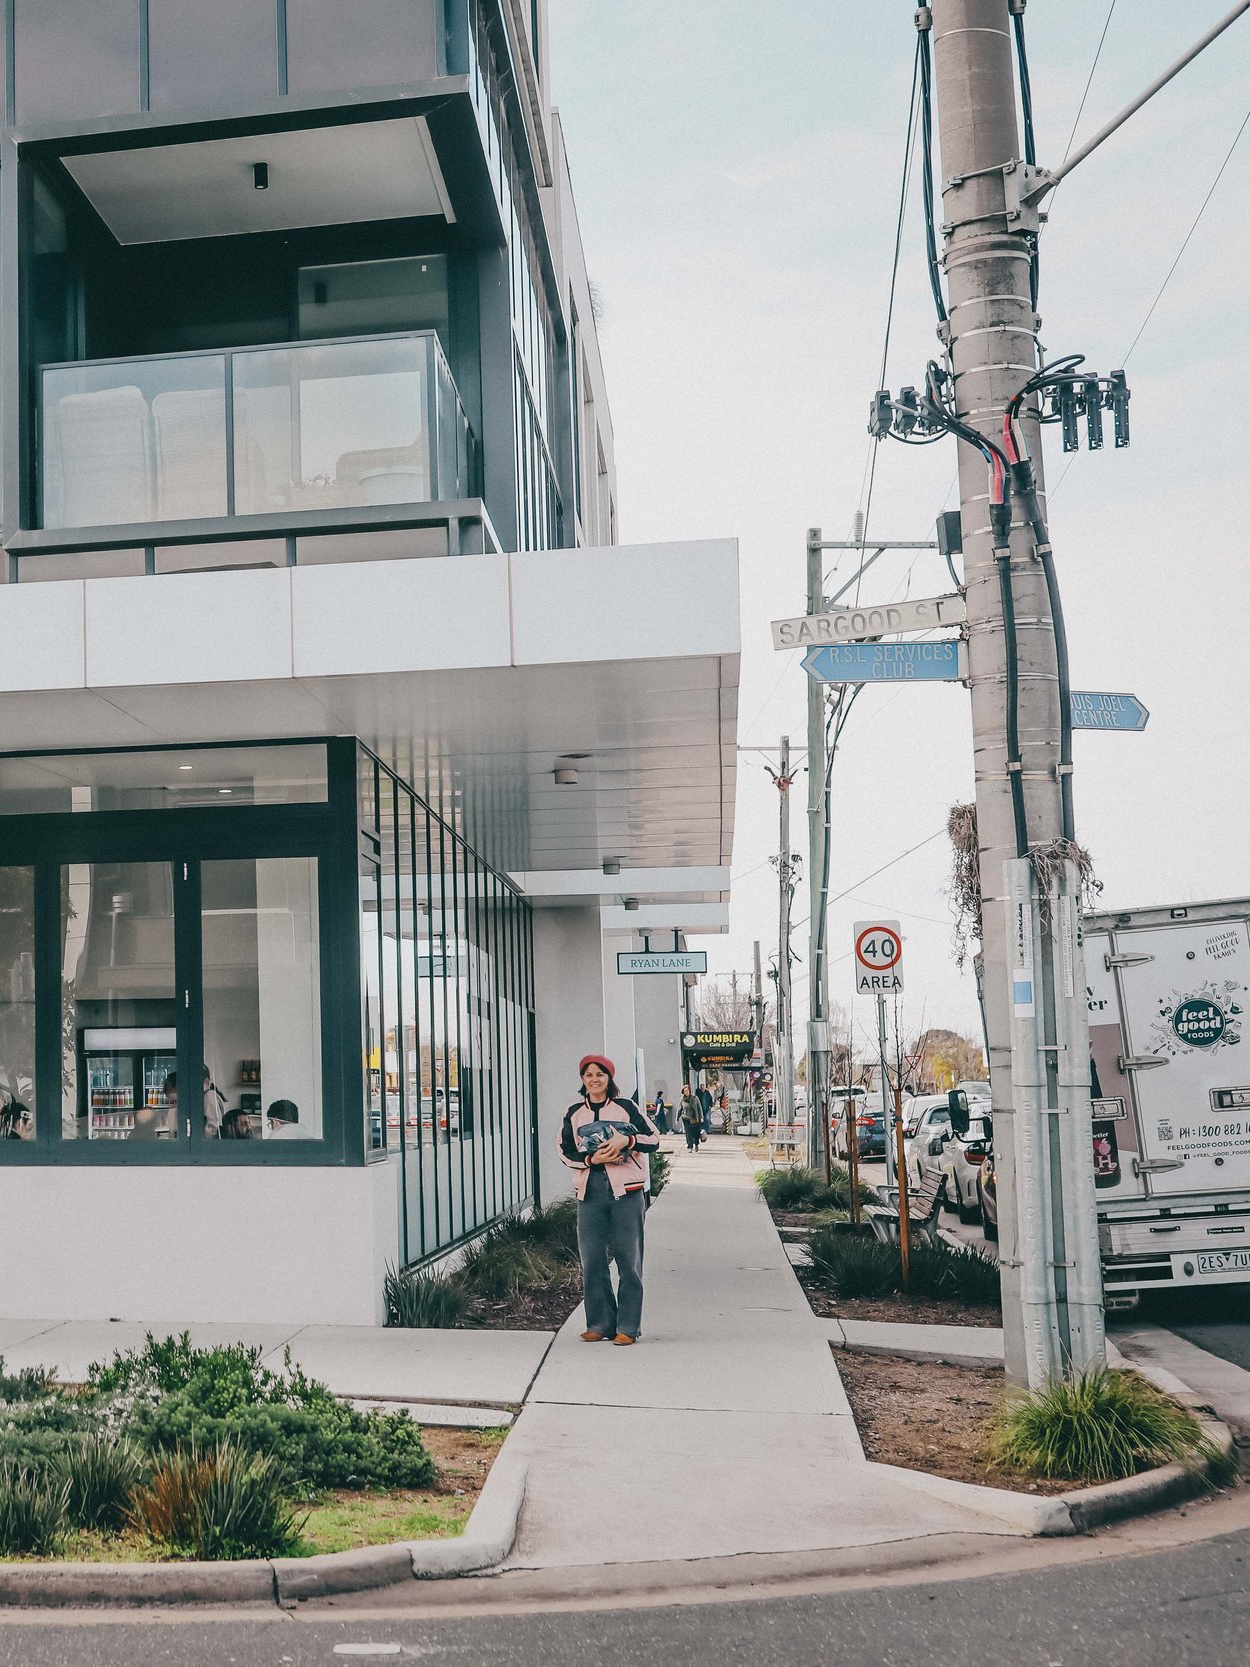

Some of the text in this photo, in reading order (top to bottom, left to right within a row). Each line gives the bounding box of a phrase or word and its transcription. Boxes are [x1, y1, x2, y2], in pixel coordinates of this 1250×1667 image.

[780, 601, 944, 645] SARGOOD ST
[873, 644, 954, 662] SERVICES
[872, 663, 915, 679] CLUB
[1099, 696, 1127, 712] JOEL
[1074, 710, 1121, 726] CENTRE
[863, 938, 895, 958] 40
[630, 958, 692, 968] RYAN LANE
[860, 975, 902, 989] AREA
[1181, 1007, 1216, 1022] feel
[1177, 1016, 1222, 1034] good
[697, 1034, 749, 1043] KUMBIRA
[1187, 1031, 1215, 1039] FOODS
[1198, 1125, 1221, 1138] 1300
[1224, 1123, 1241, 1136] 882
[1200, 1256, 1224, 1269] 2ES
[1232, 1253, 1250, 1267] 7U
